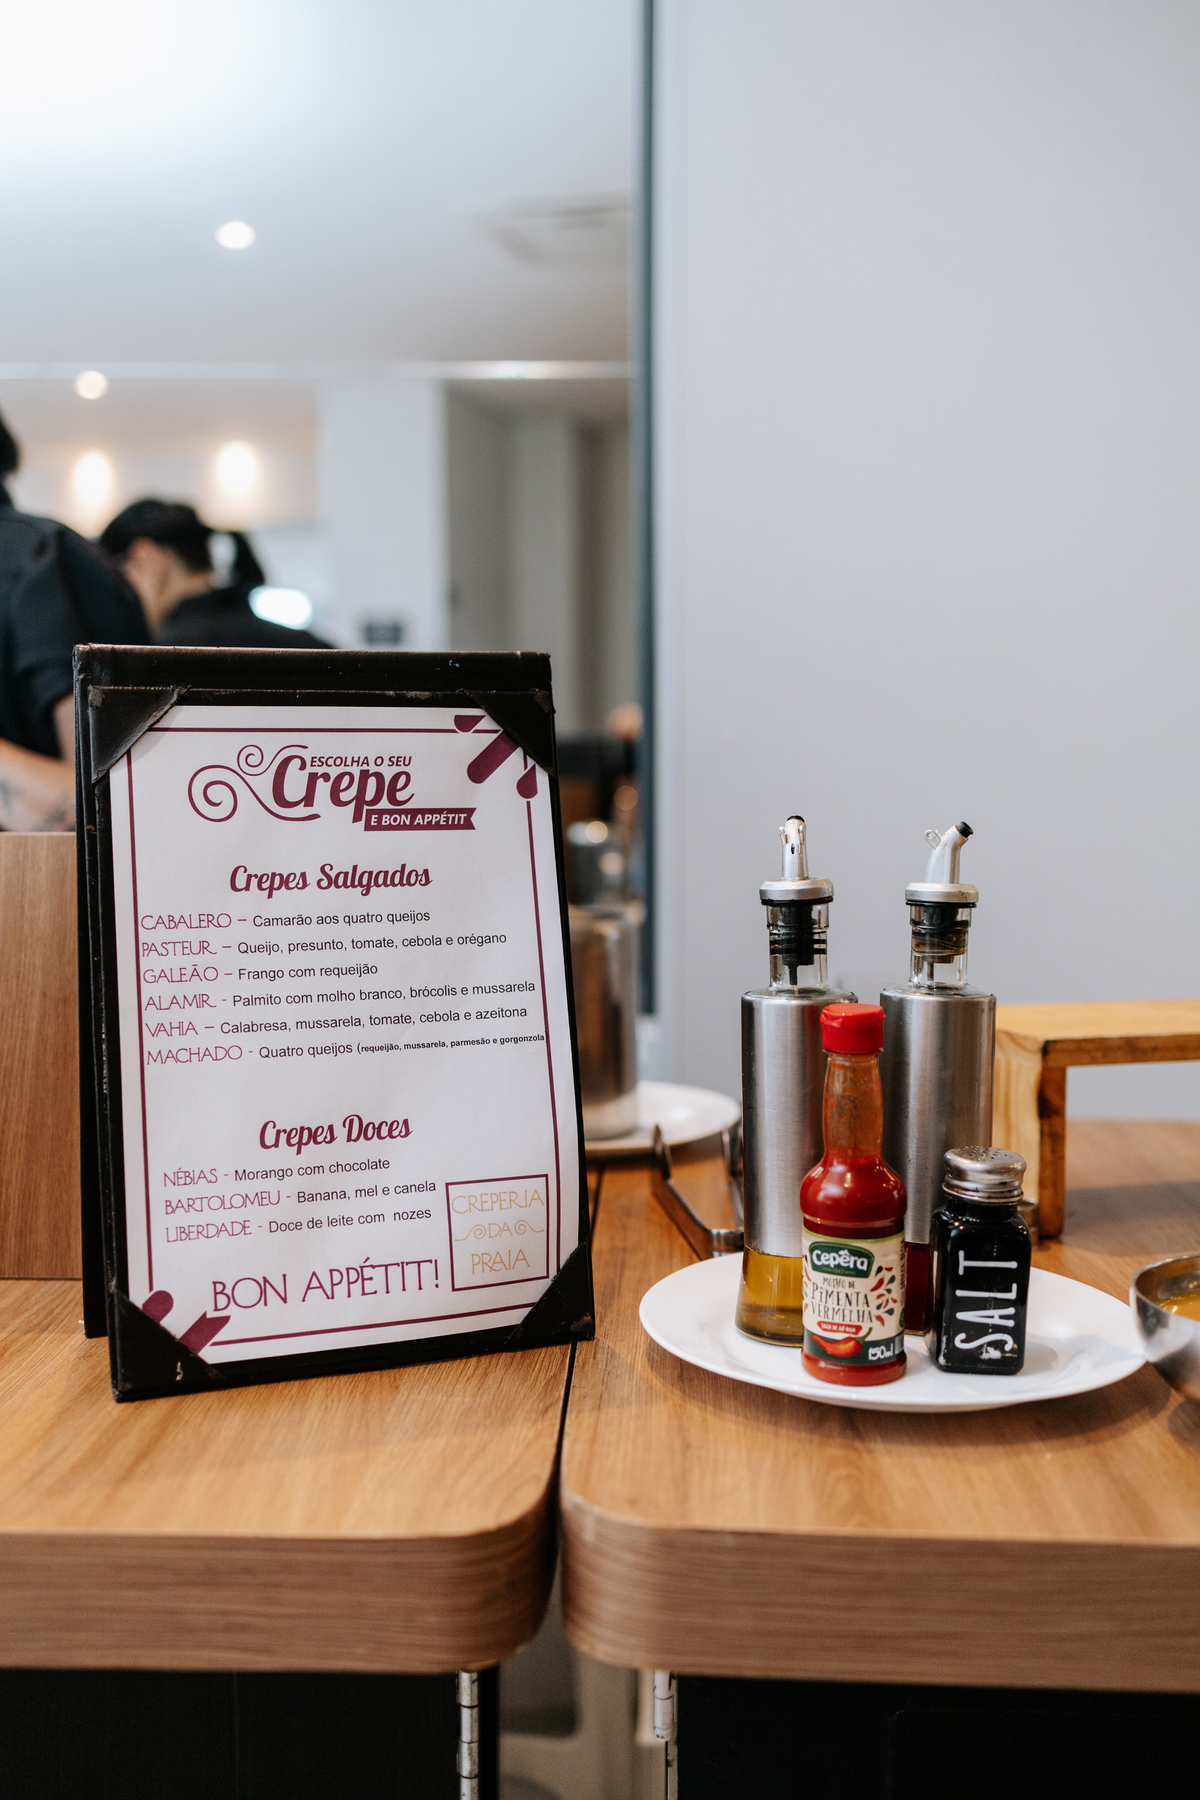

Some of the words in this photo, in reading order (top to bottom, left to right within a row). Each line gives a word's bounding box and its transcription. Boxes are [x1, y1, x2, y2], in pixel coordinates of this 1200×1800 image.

[310, 756, 369, 767] ESCOLHA
[374, 756, 384, 767] O
[388, 756, 412, 767] SEU
[272, 755, 415, 824] Crepe
[370, 813, 379, 826] E
[381, 812, 412, 826] BON
[413, 810, 467, 826] APPÉTIT
[230, 865, 311, 899] Crepes
[317, 863, 433, 896] Salgados
[141, 913, 232, 930] CABALERO
[253, 914, 312, 927] Camarão
[317, 915, 339, 925] aos
[343, 912, 383, 926] quatro
[387, 910, 430, 925] queijos
[142, 940, 217, 957] PASTEUR
[238, 941, 283, 955] Queijo,
[288, 939, 347, 954] presunto,
[351, 937, 397, 949] tomate,
[402, 935, 442, 947] cebola
[446, 937, 454, 946] e
[457, 933, 506, 947] orégano
[143, 964, 218, 983] GALEÃO
[239, 969, 284, 981] Frango
[289, 968, 315, 978] com
[320, 964, 377, 978] requeijão
[145, 994, 217, 1011] ALAMIR
[233, 994, 281, 1006] Palmito
[286, 994, 312, 1004] com
[317, 990, 355, 1002] molho
[360, 989, 405, 1000] branco,
[410, 985, 457, 998] brócolis
[461, 987, 469, 996] e
[473, 981, 535, 994] mussarela
[145, 1021, 198, 1037] VAHIA
[221, 1021, 291, 1034] Calabresa,
[296, 1016, 365, 1029] mussarela,
[369, 1013, 415, 1026] tomate,
[420, 1010, 460, 1023] cebola
[464, 1012, 472, 1021] e
[476, 1007, 527, 1020] azeitona
[147, 1045, 242, 1065] MACHADO
[259, 1046, 303, 1058] Quatro
[308, 1043, 353, 1058] queijos
[404, 1040, 448, 1049] mussarela,
[451, 1038, 490, 1048] parmesão
[259, 1120, 338, 1155] Crepes
[342, 1114, 413, 1143] Doces
[164, 1167, 218, 1187] NÉBIAS
[235, 1168, 293, 1181] Morango
[298, 1165, 324, 1176] com
[329, 1158, 390, 1173] chocolate
[165, 1190, 280, 1215] BARTOLOMEU
[297, 1190, 350, 1203] Banana,
[355, 1185, 377, 1198] mel
[382, 1187, 391, 1196] e
[394, 1181, 436, 1194] canela
[452, 1189, 545, 1214] CREPERIA
[166, 1220, 252, 1242] LIBERDADE
[269, 1221, 302, 1233] Doce
[307, 1217, 322, 1229] de
[327, 1215, 353, 1227] leite
[358, 1214, 385, 1224] com
[394, 1209, 431, 1221] nozes
[488, 1222, 513, 1238] DA
[471, 1248, 530, 1275] PRAIA
[812, 1249, 868, 1271] Cepêra
[212, 1274, 287, 1312] BON
[302, 1257, 439, 1302] APPÉTIT!
[823, 1276, 846, 1289] MOLHO
[848, 1280, 855, 1289] DE
[811, 1301, 873, 1323] VERMELHA
[954, 1250, 1018, 1351] SALT
[868, 1343, 894, 1360] 150ml
